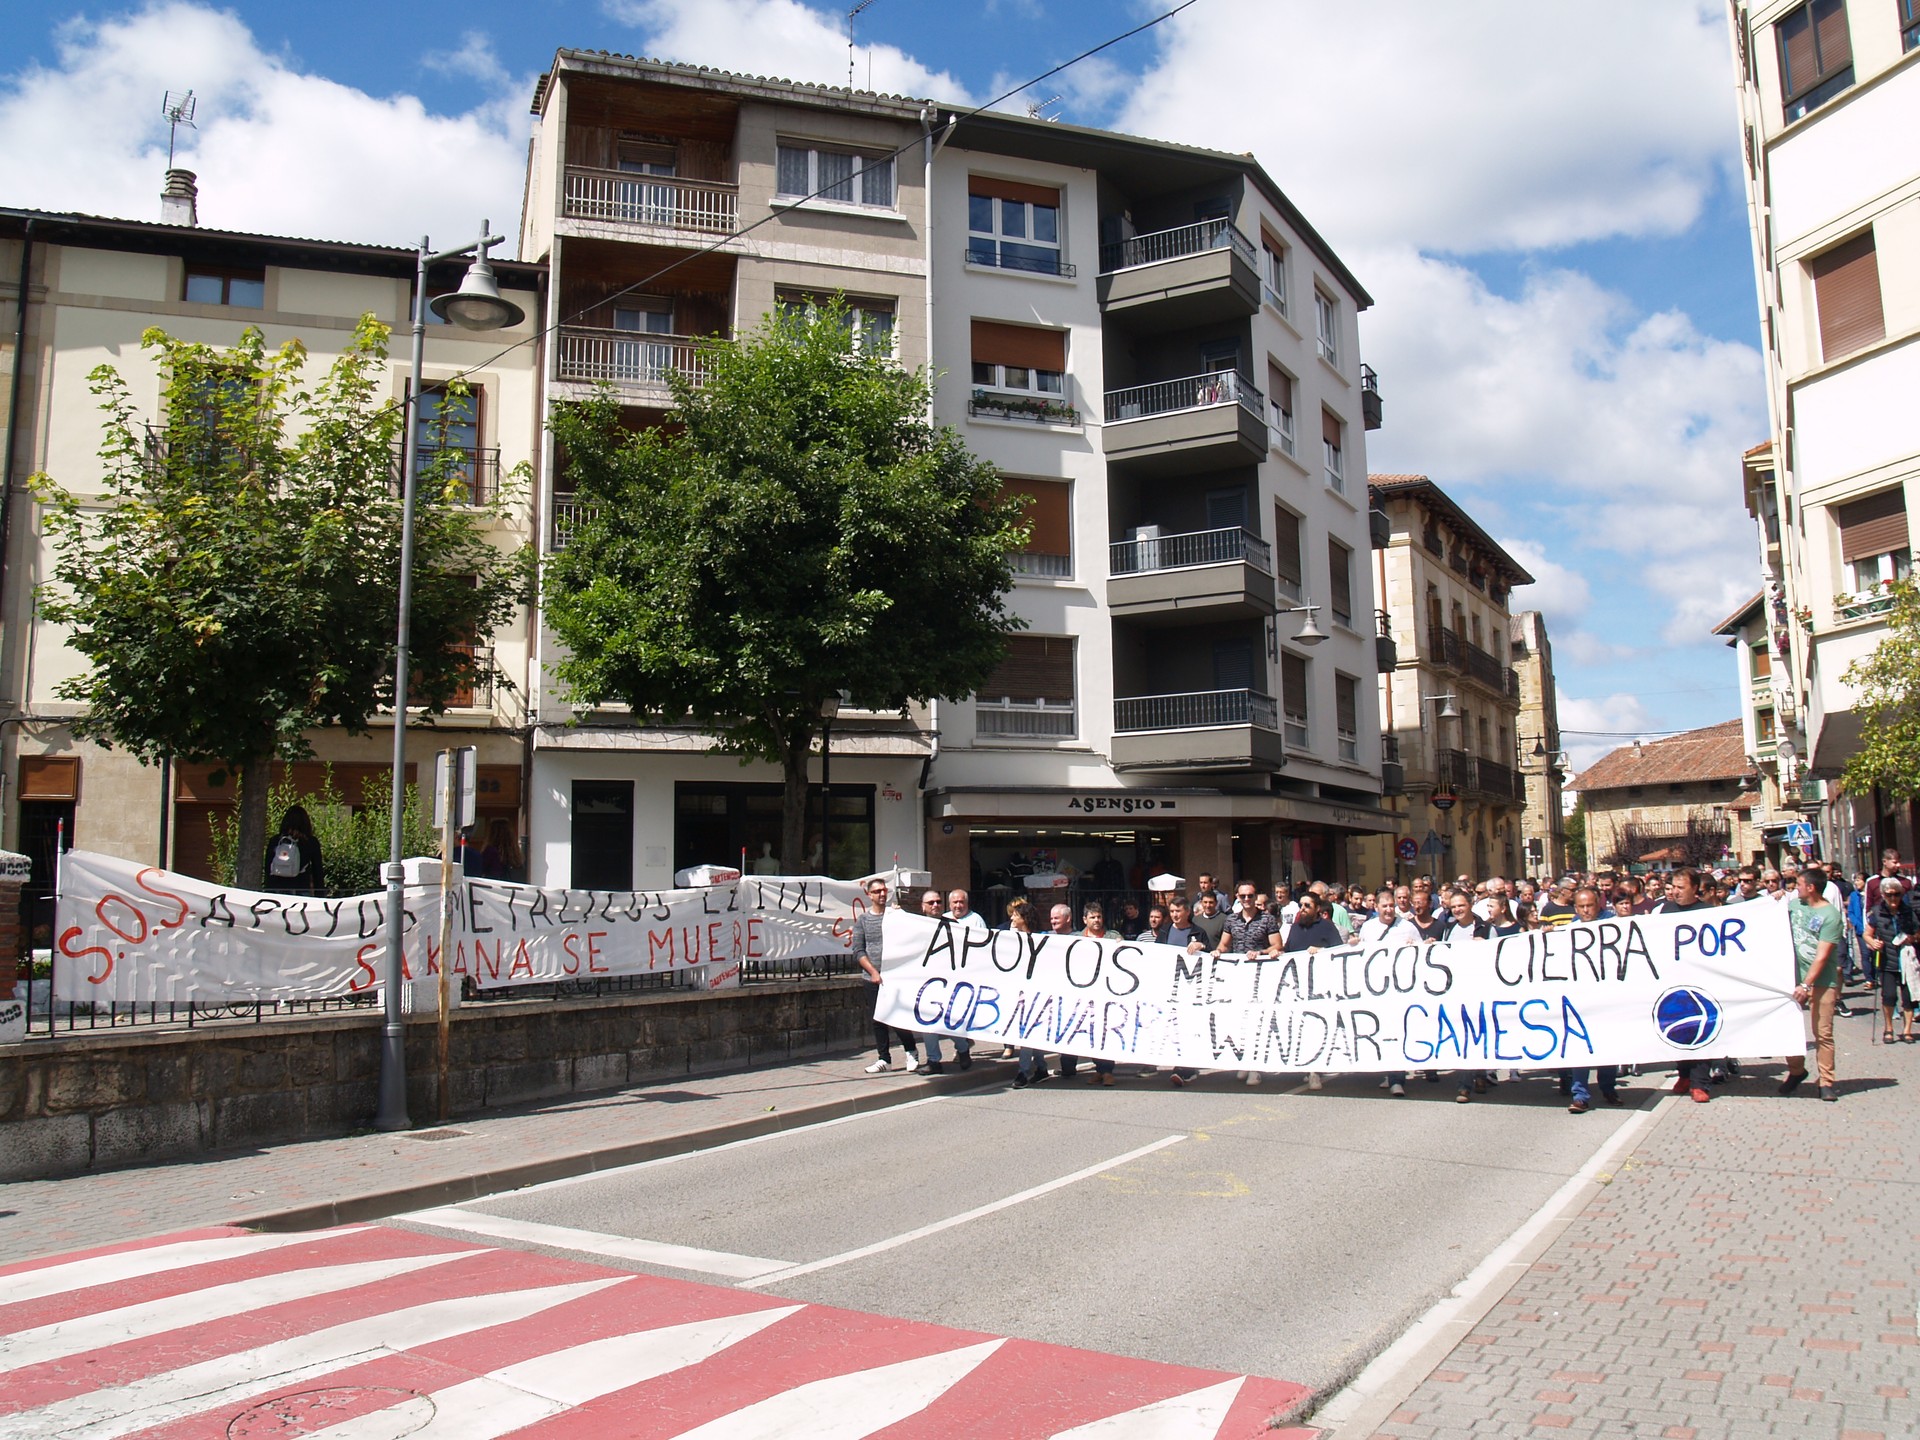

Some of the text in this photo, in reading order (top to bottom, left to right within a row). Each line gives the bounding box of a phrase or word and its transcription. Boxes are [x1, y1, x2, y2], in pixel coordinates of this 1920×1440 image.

[1067, 797, 1156, 814] ASENSIO
[562, 931, 609, 974] SE
[647, 917, 764, 970] MUERE
[922, 915, 1144, 996] APOYOS
[1494, 920, 1660, 987] CIERRA
[1674, 917, 1747, 961] POR
